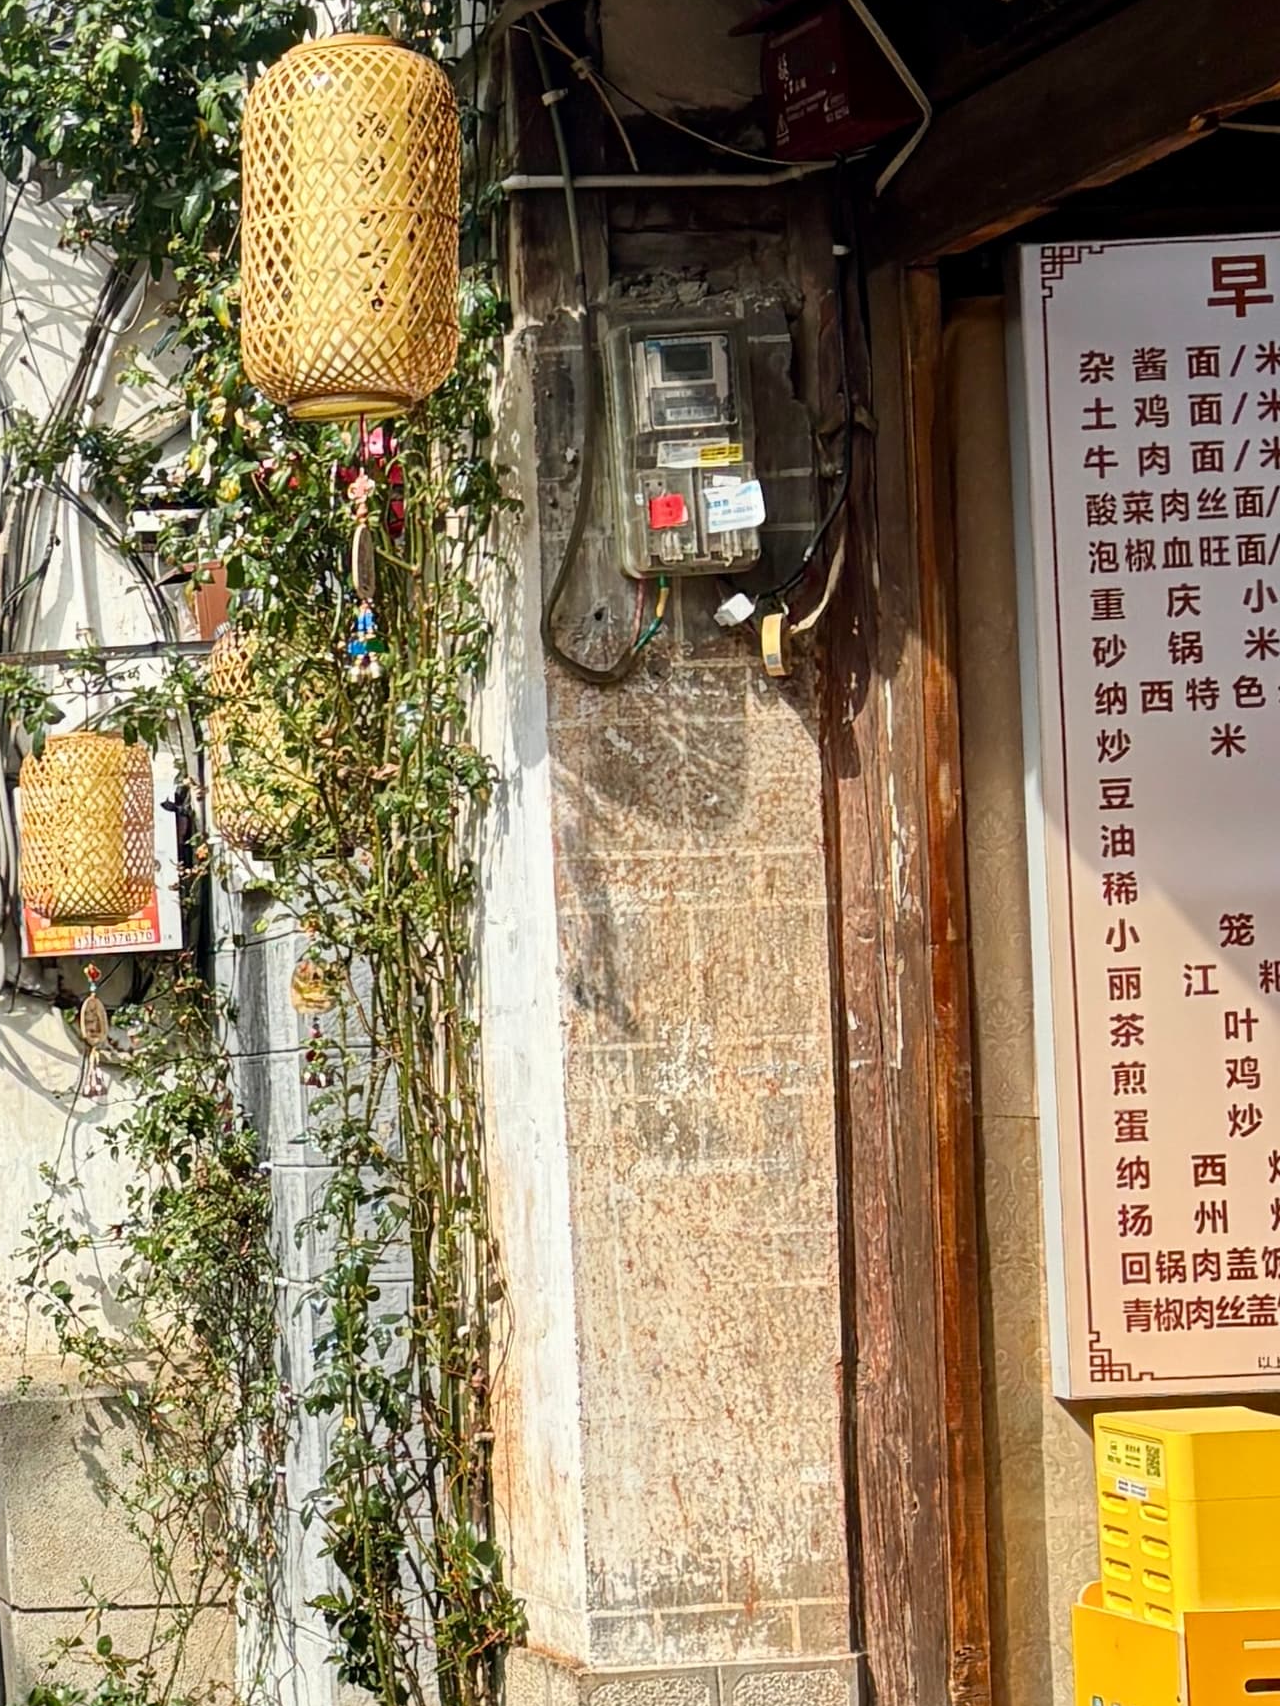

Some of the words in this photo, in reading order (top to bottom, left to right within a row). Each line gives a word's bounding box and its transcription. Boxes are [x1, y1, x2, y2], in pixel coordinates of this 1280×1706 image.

[1207, 254, 1274, 318] 早
[1094, 675, 1280, 716] 纳西特色
[1123, 1293, 1280, 1334] 青椒肉丝盖
